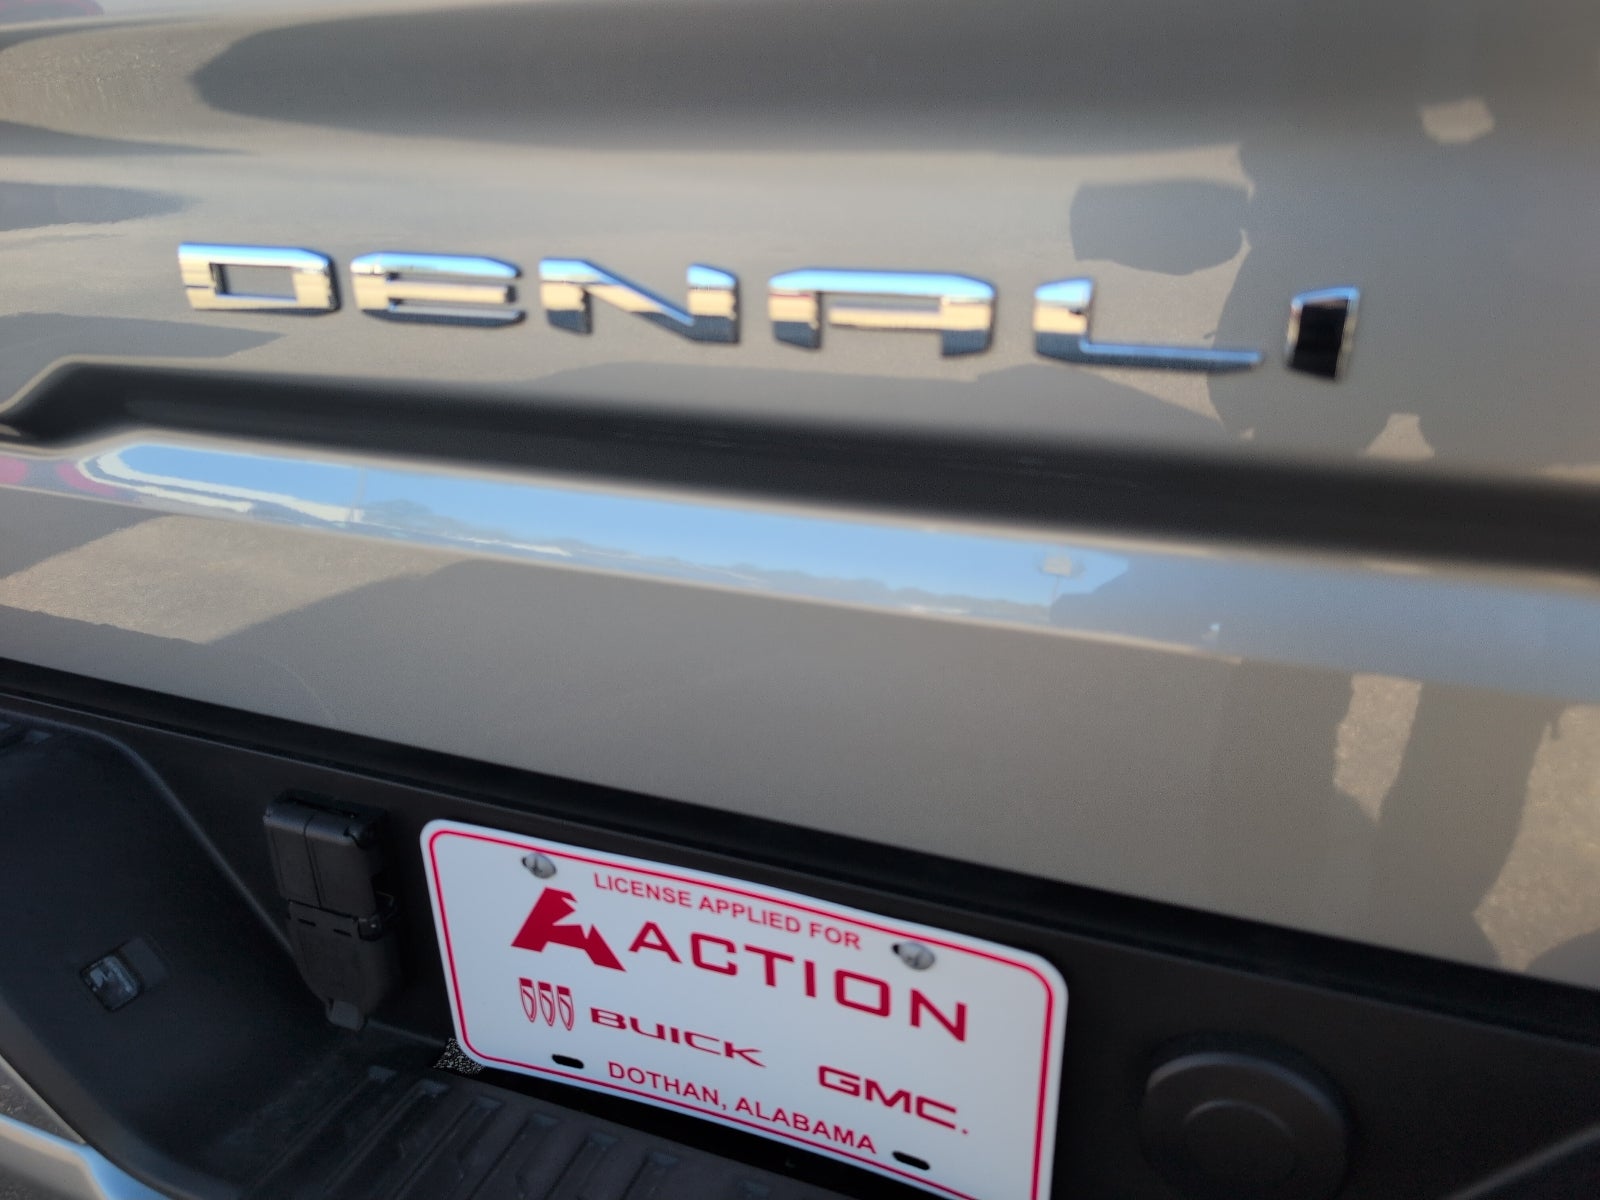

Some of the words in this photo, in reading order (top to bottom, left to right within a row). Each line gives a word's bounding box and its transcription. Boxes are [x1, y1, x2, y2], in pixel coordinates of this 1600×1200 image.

[178, 241, 1360, 380] DENALI
[593, 872, 692, 907] LICENSE
[698, 895, 803, 934] APPLIED
[808, 921, 862, 950] FOR
[628, 920, 969, 1043] ACTION
[590, 1007, 765, 1068] BUICK
[608, 1060, 729, 1112] DOTHAN,
[735, 1096, 877, 1155] ALABAMA
